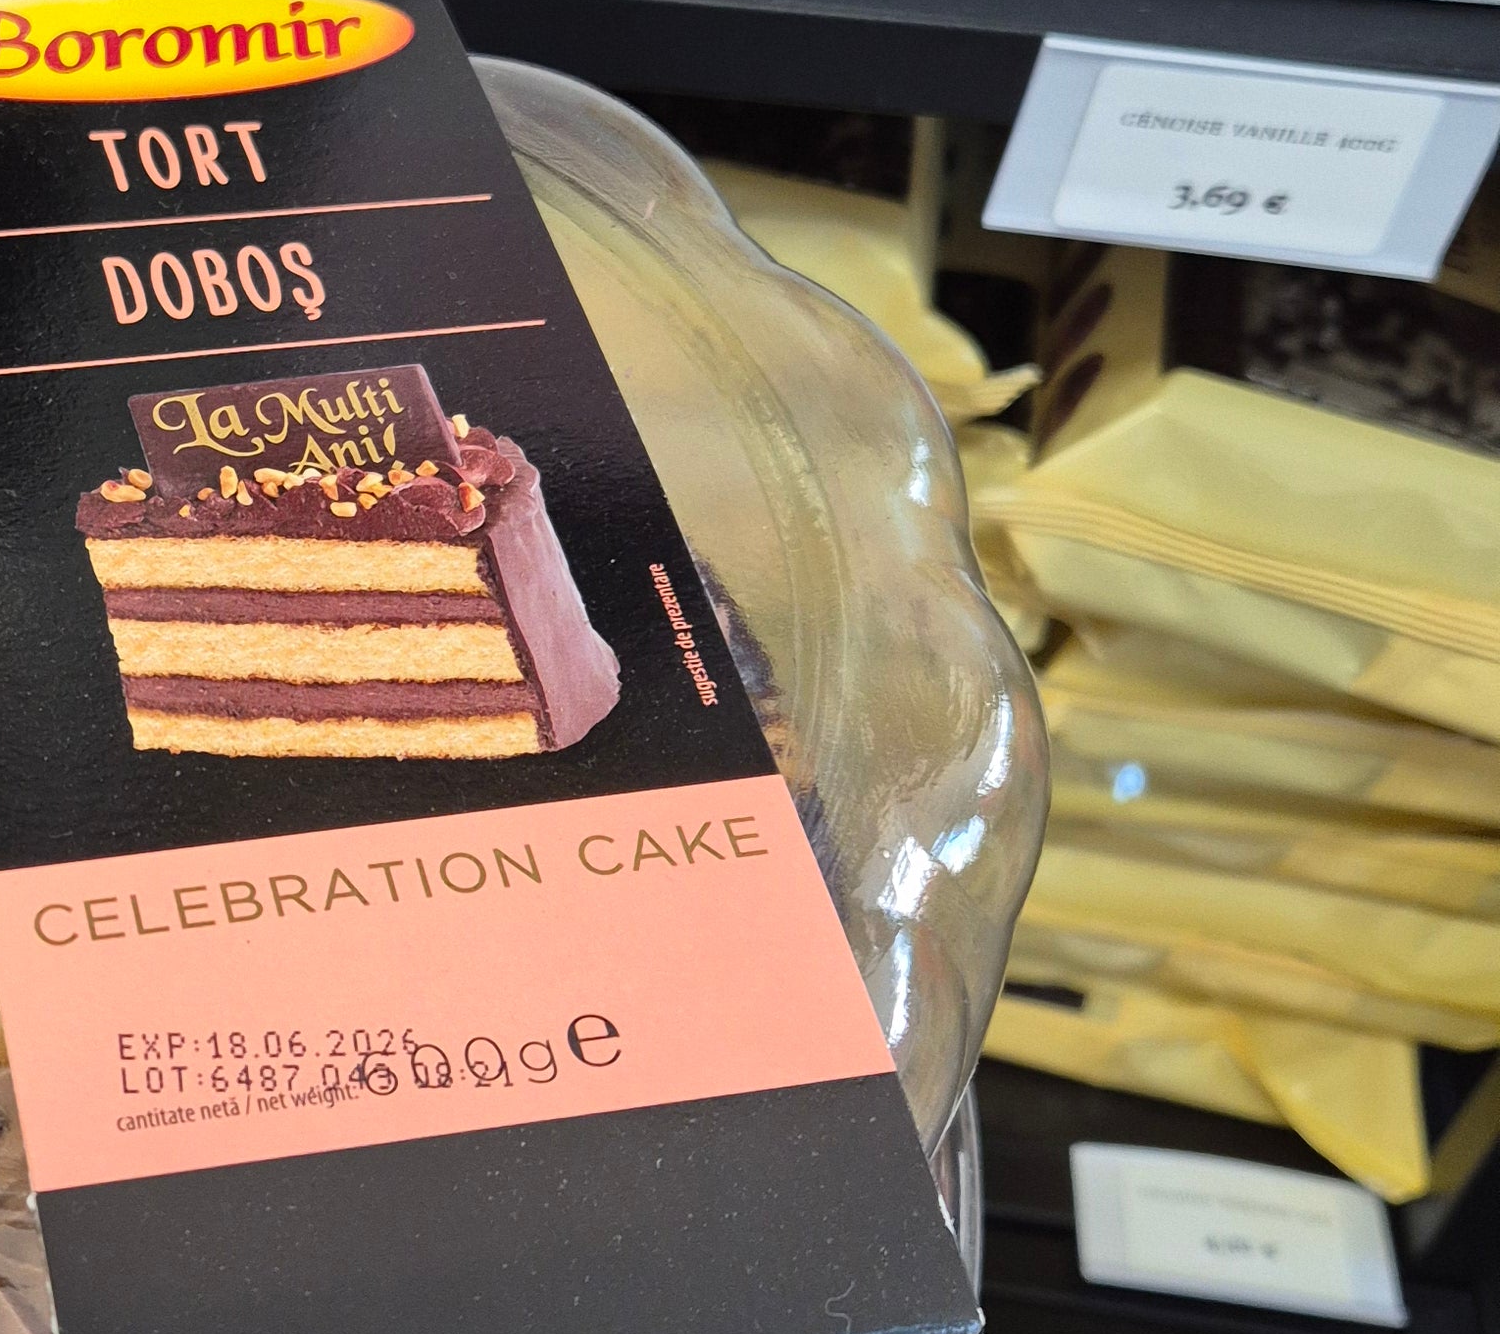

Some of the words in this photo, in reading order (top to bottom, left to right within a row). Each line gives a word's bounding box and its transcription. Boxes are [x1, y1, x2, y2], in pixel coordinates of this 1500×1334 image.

[89, 120, 268, 192] TORT
[152, 392, 265, 457] La
[289, 422, 405, 475] Ani!
[649, 562, 693, 630] prezentare
[674, 631, 696, 649] de
[682, 650, 718, 707] sugestie
[33, 843, 545, 947] CELEBRATION
[578, 816, 770, 876] CAKE
[117, 1028, 418, 1060] EXP:18.06.2026
[116, 1104, 196, 1132] cantitate
[200, 1098, 240, 1121] netă
[257, 1092, 289, 1112] net
[293, 1082, 360, 1108] weight:
[120, 1065, 301, 1095] LOT:6487
